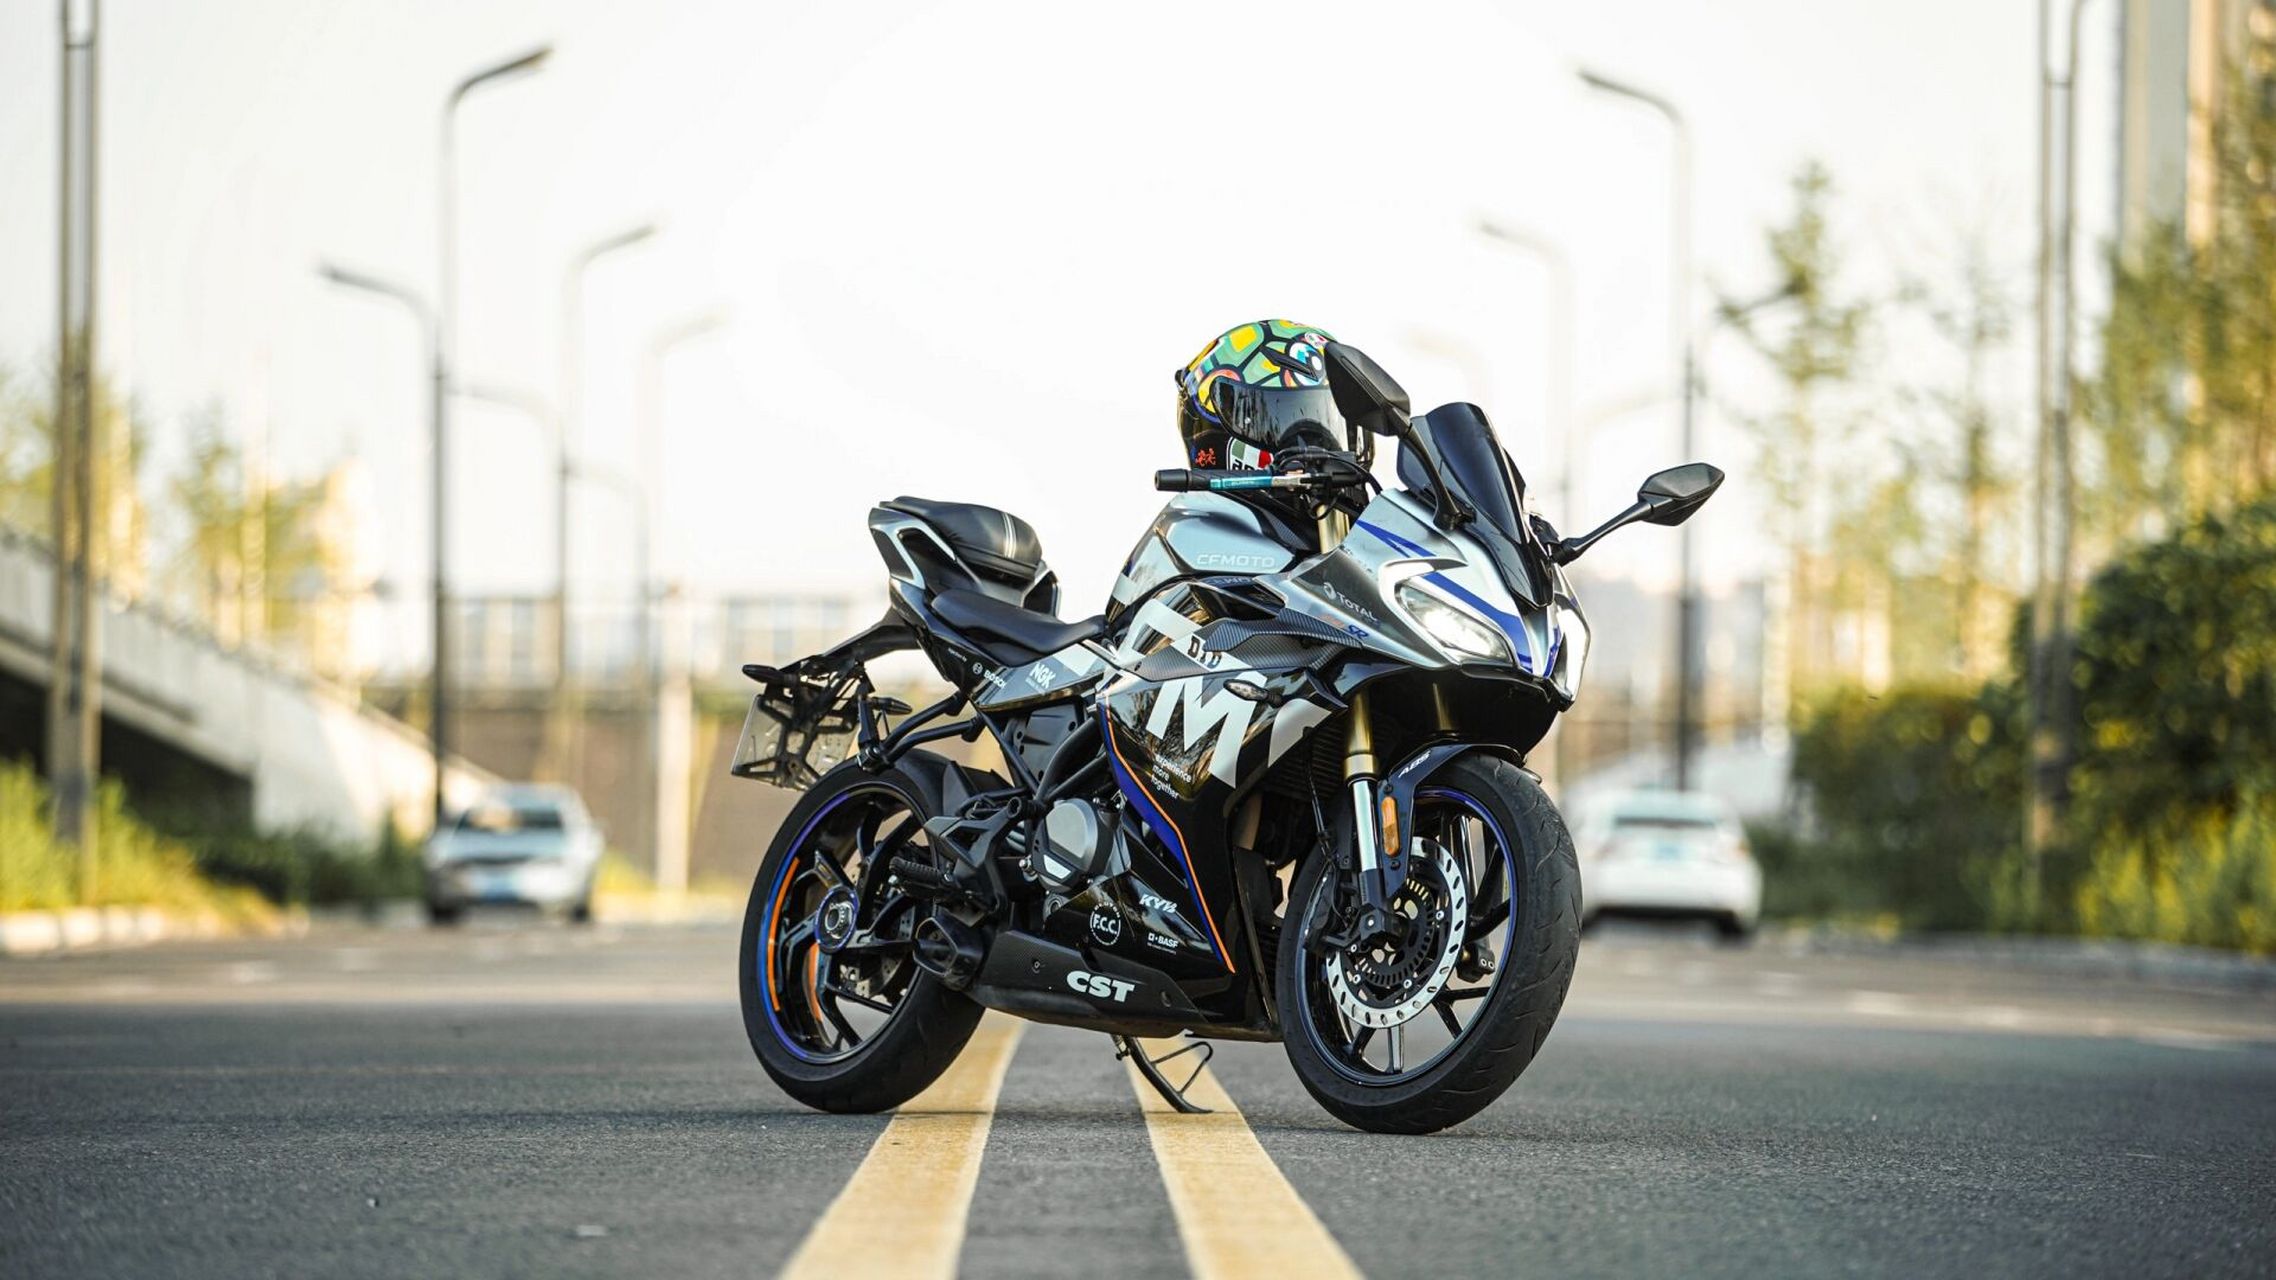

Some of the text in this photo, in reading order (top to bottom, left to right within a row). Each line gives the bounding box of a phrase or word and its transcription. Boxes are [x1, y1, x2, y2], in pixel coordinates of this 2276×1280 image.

[1197, 554, 1275, 568] CFMOTO
[1337, 591, 1378, 621] TOTAL
[1348, 624, 1369, 640] SR
[983, 669, 1007, 688] BOSCH
[1029, 661, 1056, 689] NGK
[1152, 764, 1170, 782] more
[1155, 753, 1192, 783] experience
[1398, 750, 1431, 778] ABS
[1151, 773, 1182, 799] together
[1139, 894, 1178, 914] KYB
[1158, 935, 1179, 949] BASF
[1066, 970, 1136, 1003] CST
